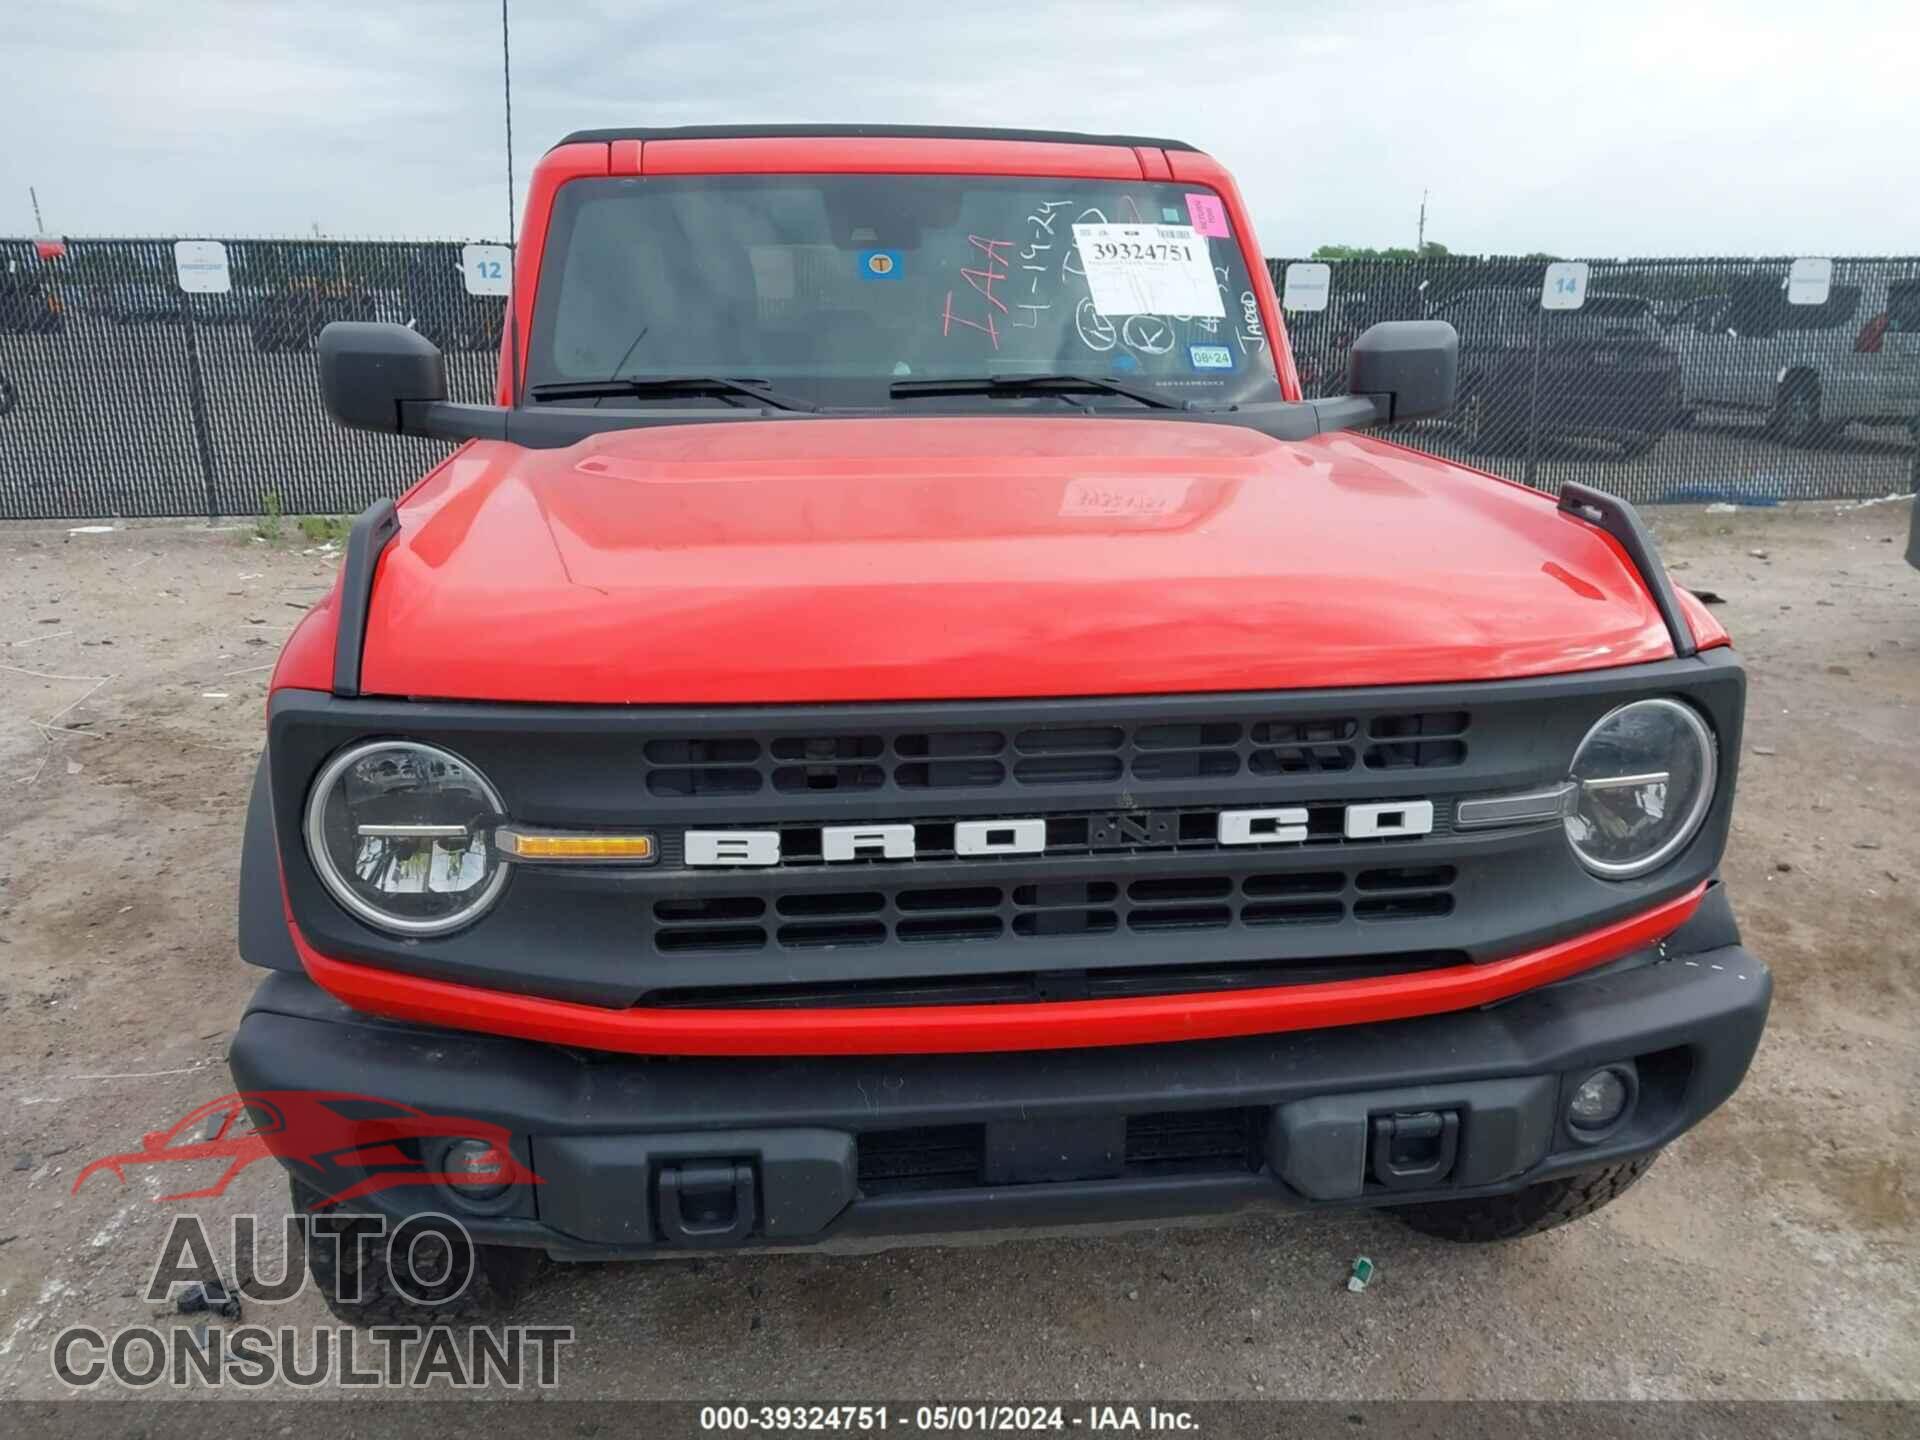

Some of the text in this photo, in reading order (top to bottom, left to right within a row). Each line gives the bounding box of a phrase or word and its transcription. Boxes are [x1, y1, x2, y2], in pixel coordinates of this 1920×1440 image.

[1092, 242, 1192, 262] 39324751
[477, 261, 502, 279] 12
[942, 234, 1015, 350] IAA
[1555, 277, 1577, 293] 14
